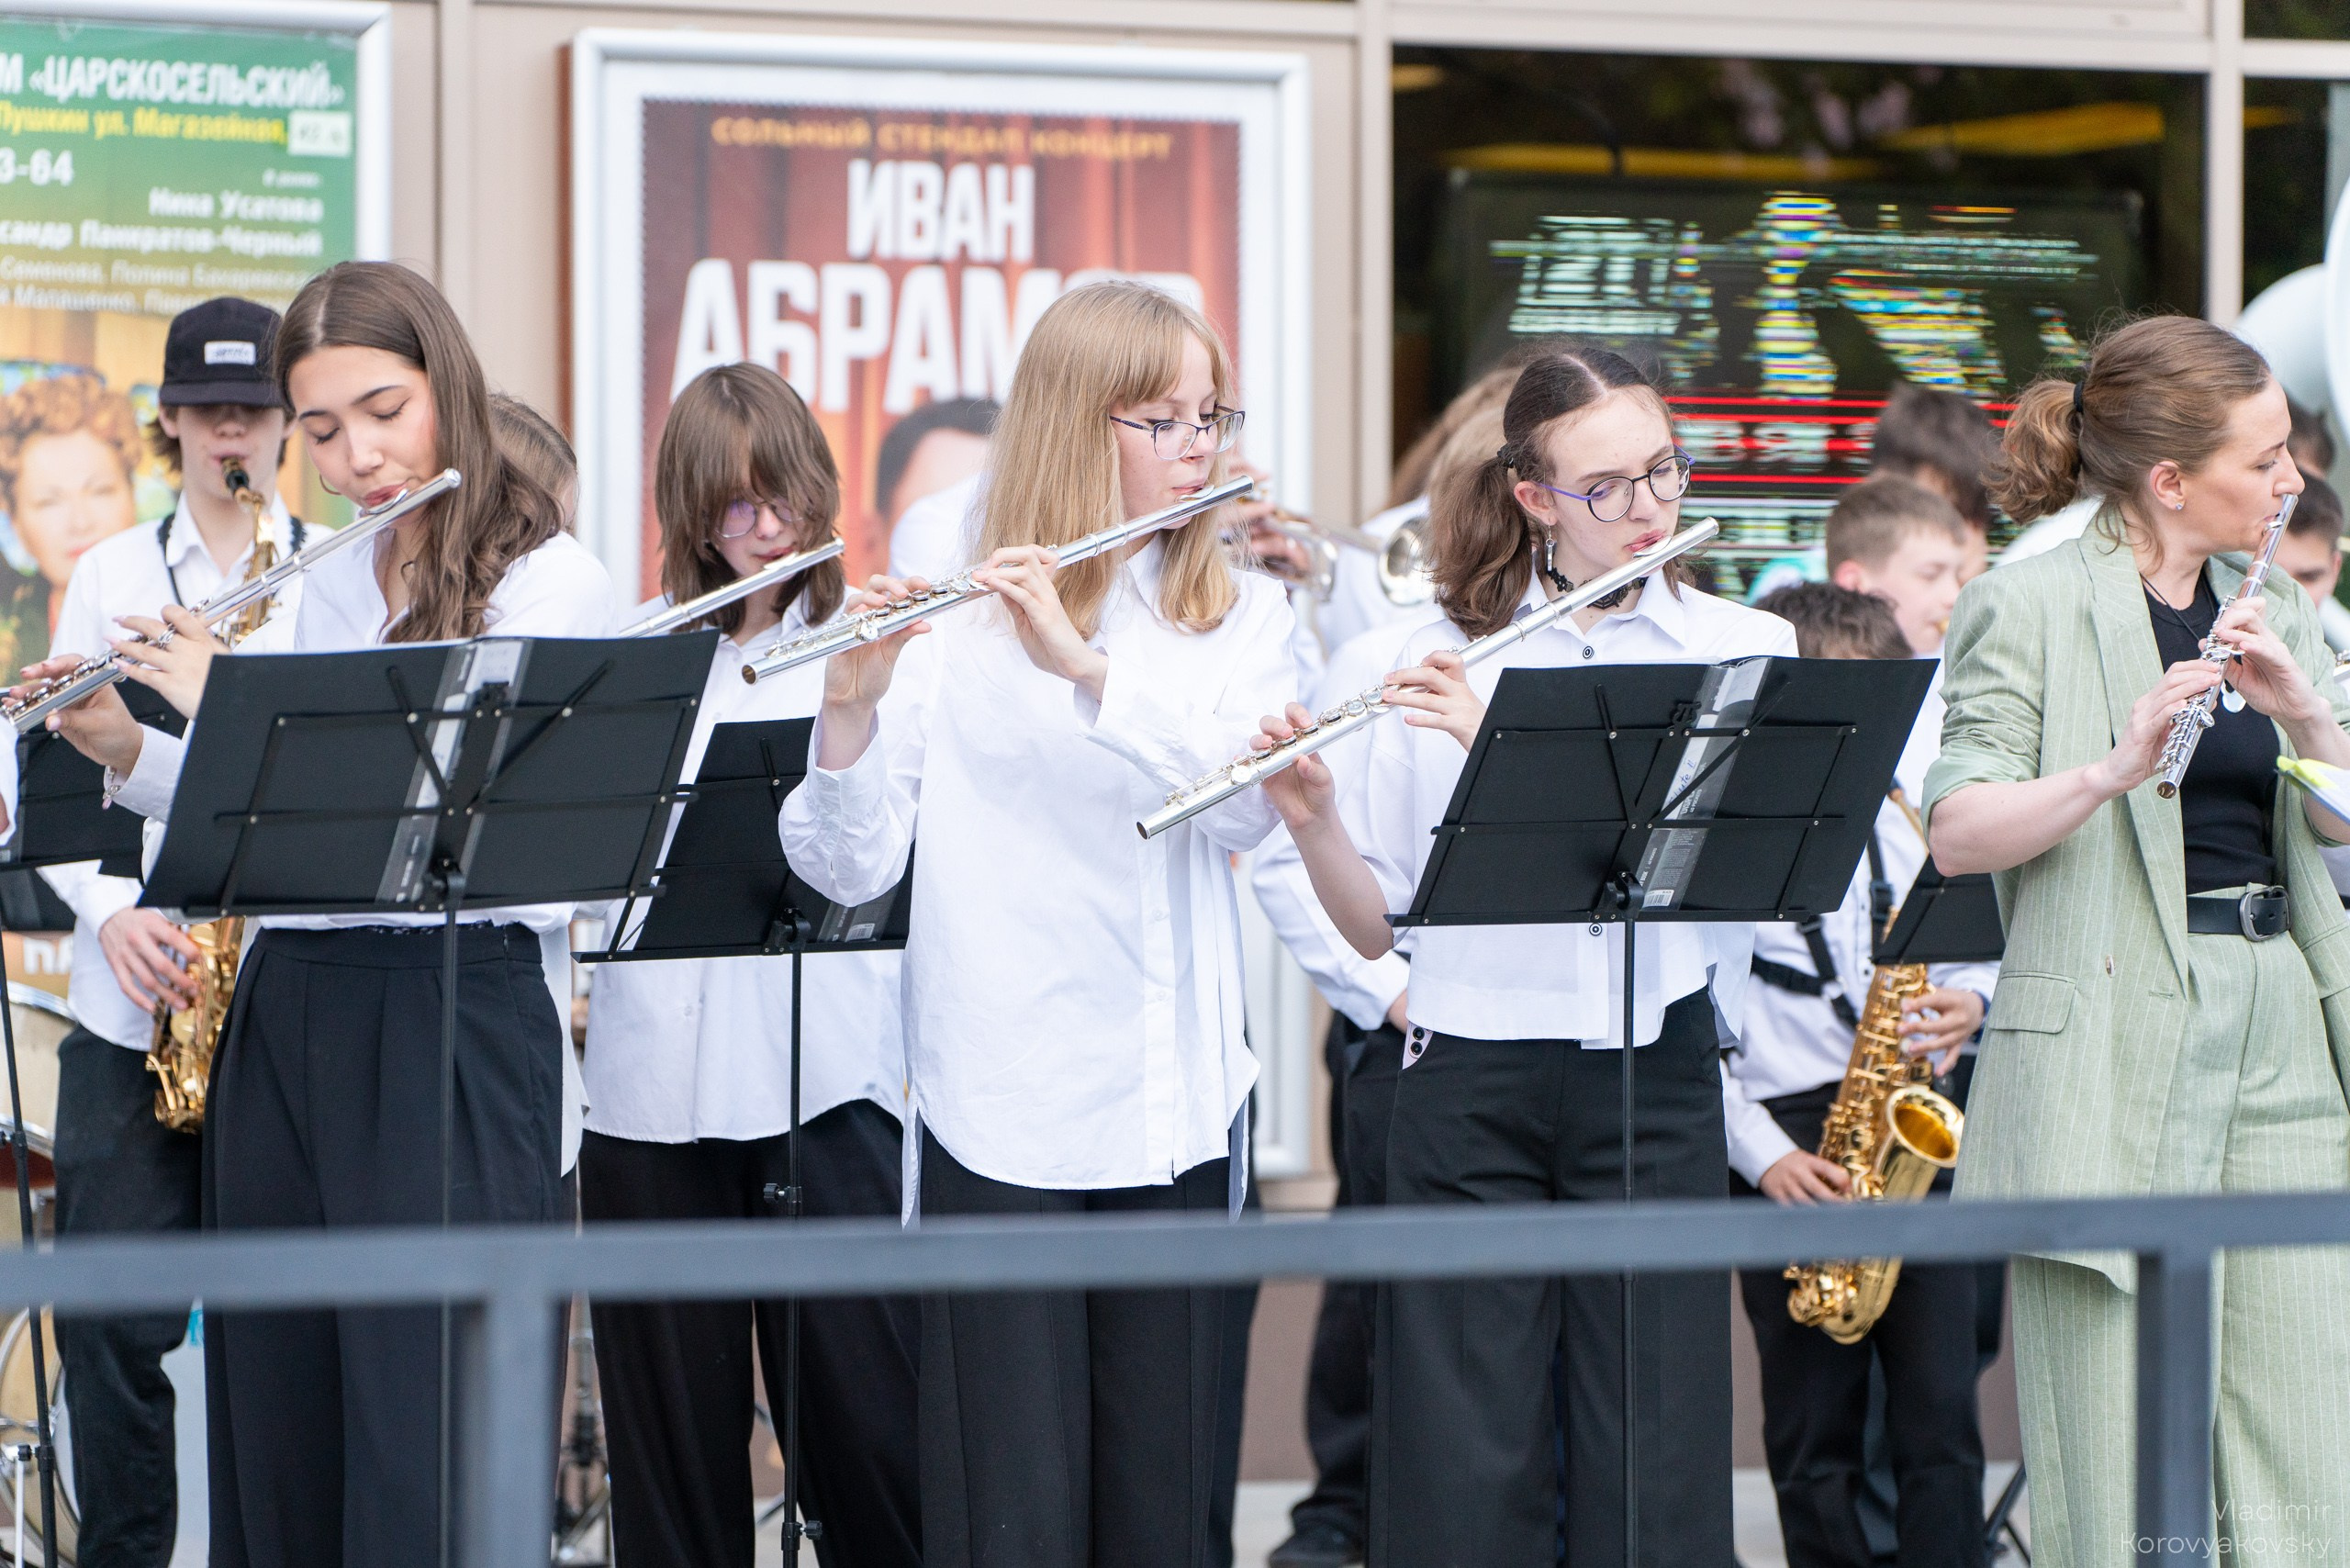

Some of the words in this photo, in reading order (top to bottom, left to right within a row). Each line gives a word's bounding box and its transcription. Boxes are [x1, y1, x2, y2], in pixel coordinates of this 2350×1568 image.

[28, 55, 345, 108] «ЦАРСКОСЕЛЬСКИЙ»
[711, 116, 871, 149] СОЛЬНЫЙ
[876, 122, 1024, 155] СТЕНДАП
[1031, 129, 1172, 162] КОНЦЕРТ
[219, 189, 324, 224] Усатова
[846, 158, 1035, 263] ИВАН
[669, 257, 1205, 415] АБРАМ
